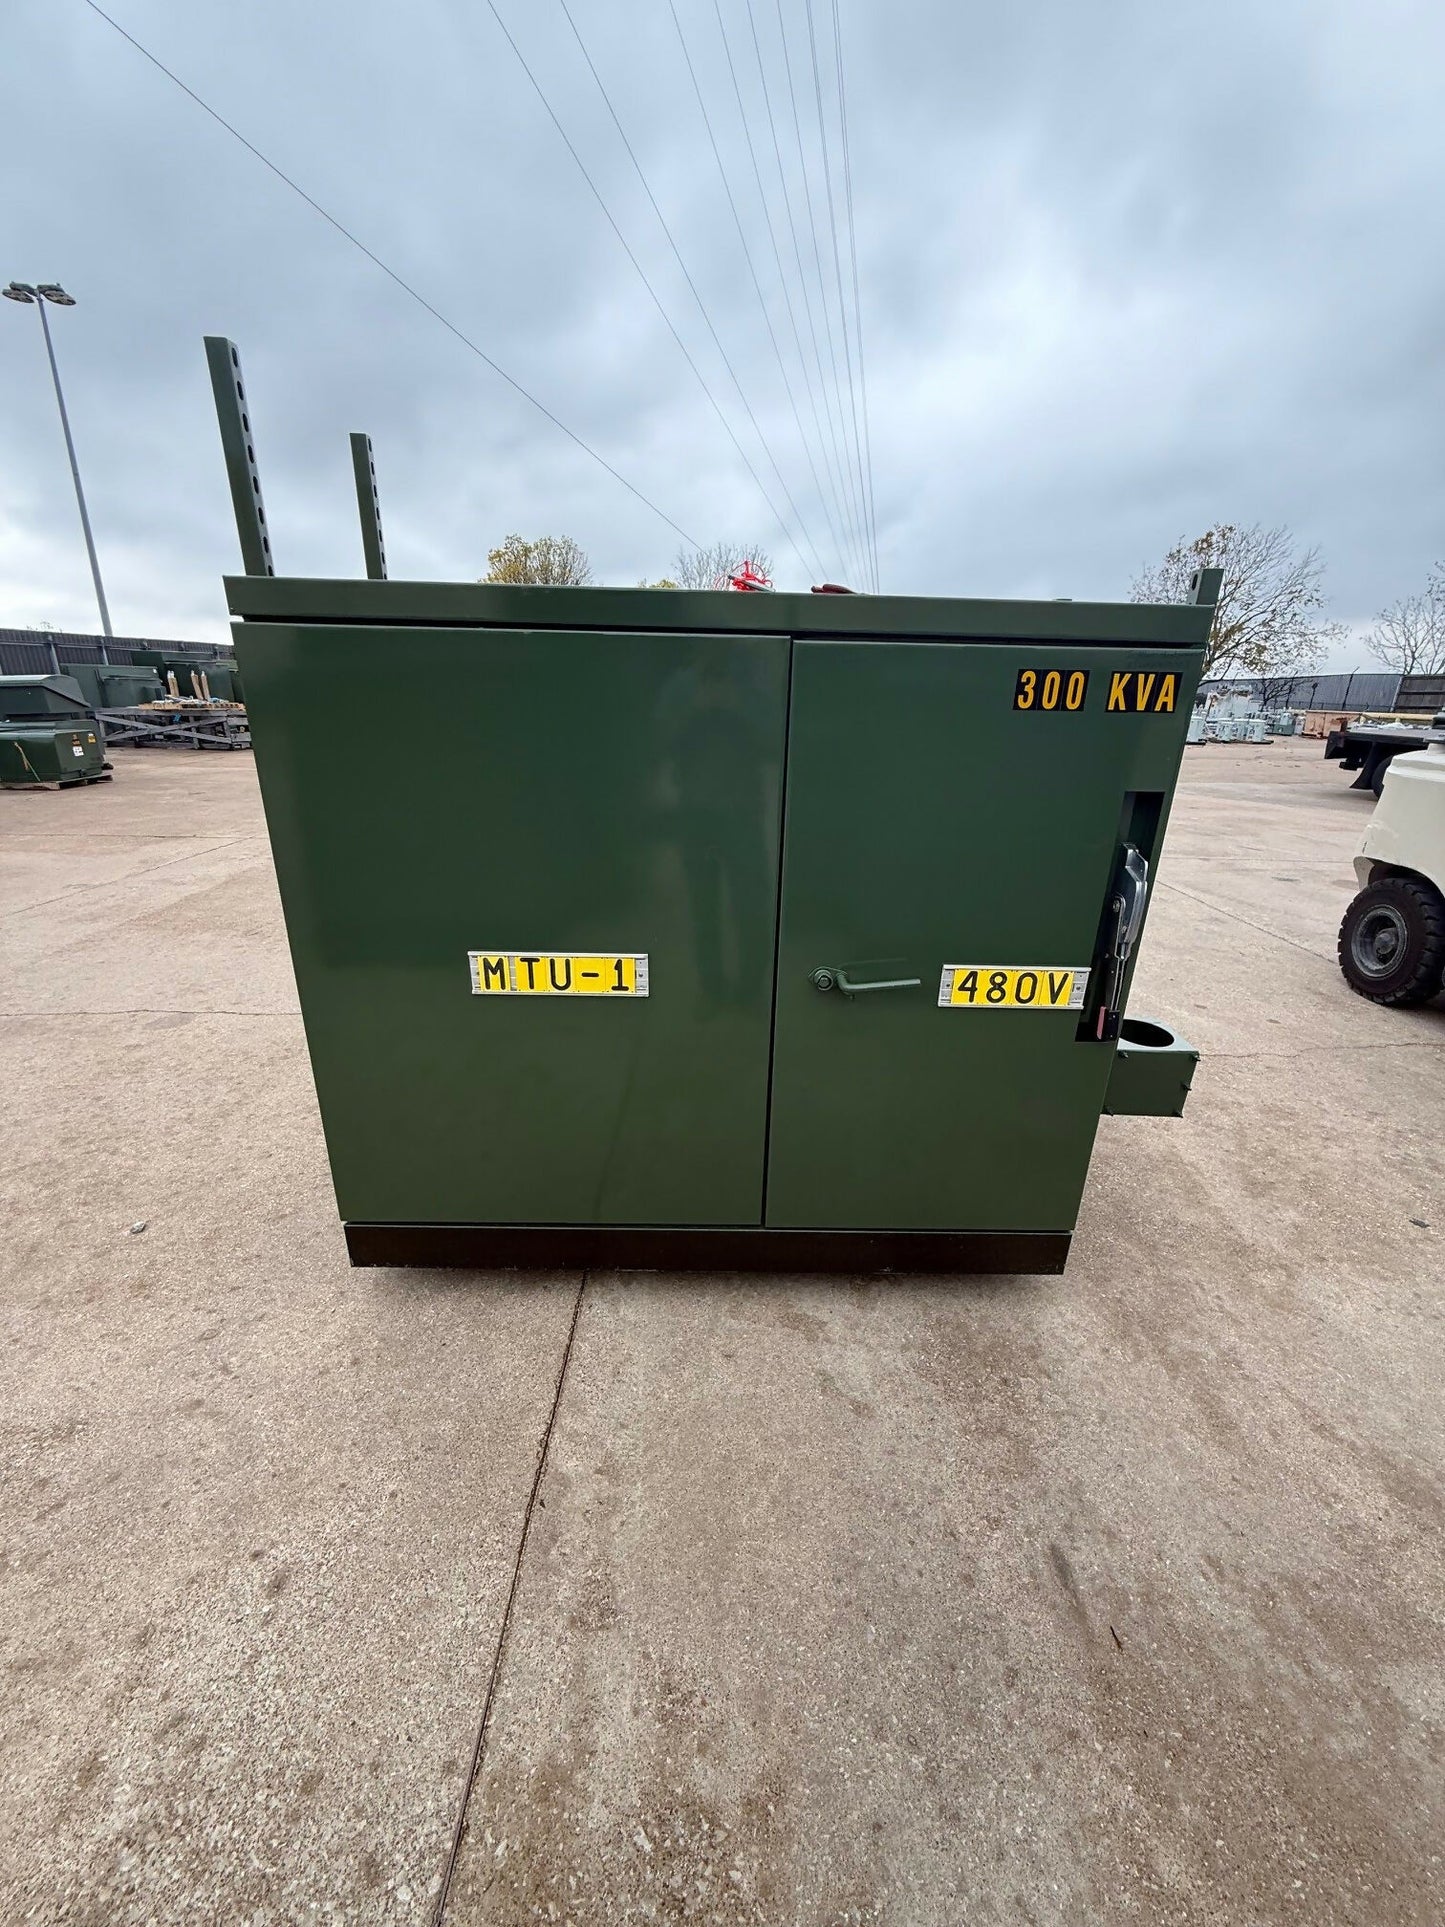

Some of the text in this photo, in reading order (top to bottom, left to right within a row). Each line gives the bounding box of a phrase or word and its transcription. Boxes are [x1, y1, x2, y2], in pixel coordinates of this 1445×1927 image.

[1018, 670, 1175, 712] 300 KVA
[483, 957, 629, 991] MTU-1
[957, 970, 1069, 1004] 480V
